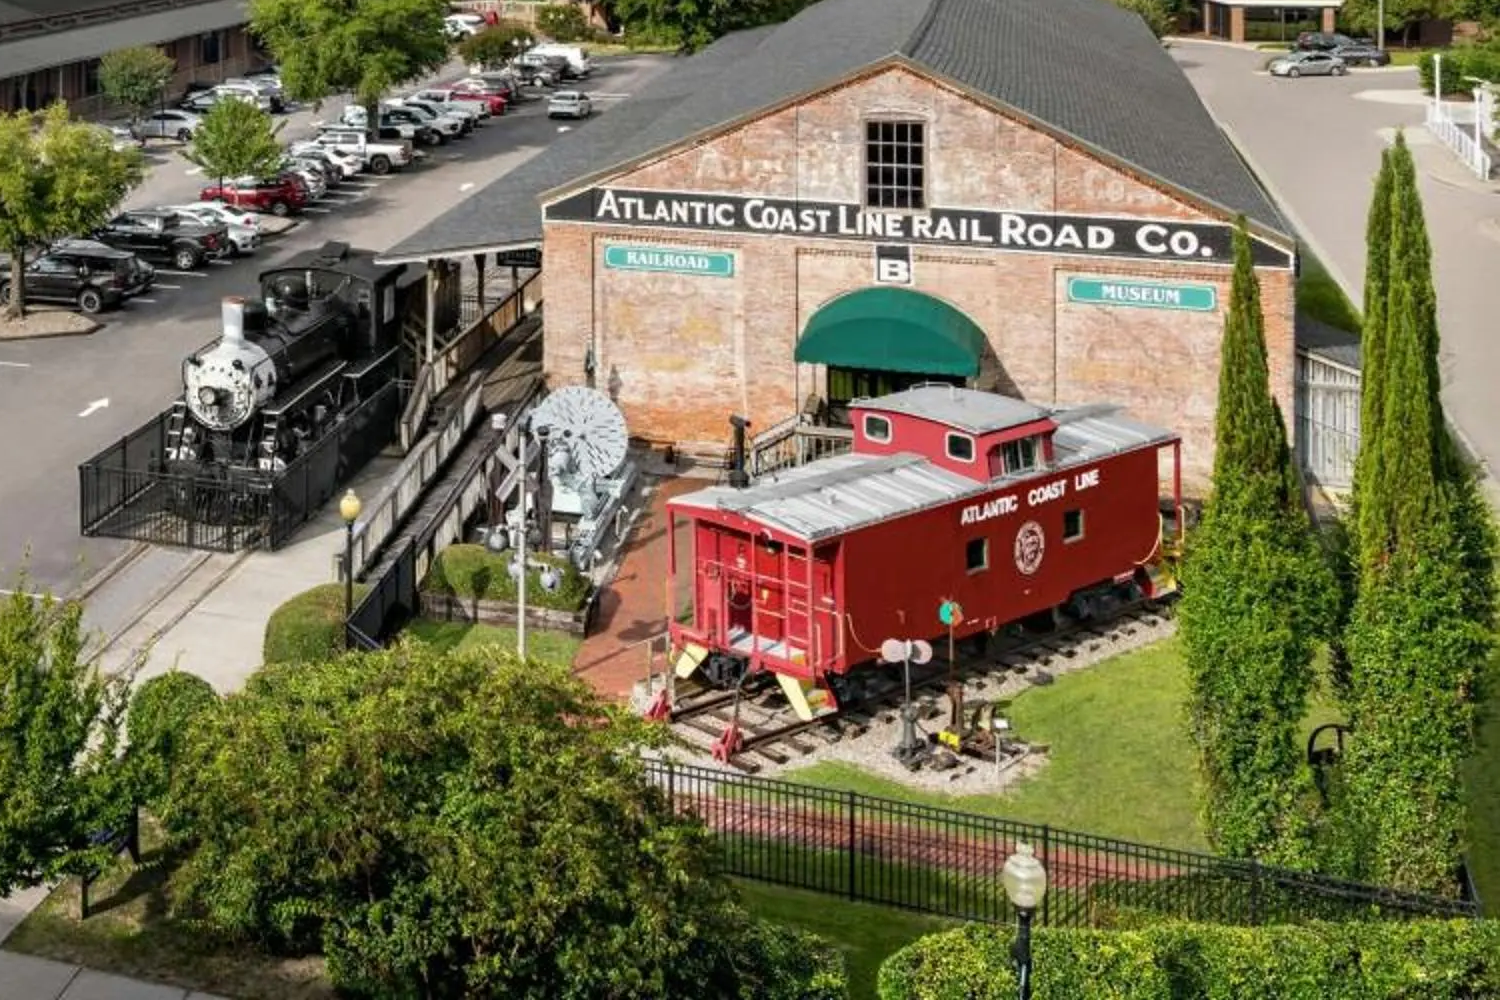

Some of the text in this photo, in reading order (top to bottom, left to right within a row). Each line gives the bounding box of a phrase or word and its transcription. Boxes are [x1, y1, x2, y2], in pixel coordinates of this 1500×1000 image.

[597, 190, 735, 227] ATLANTIC
[743, 199, 831, 233] COAST
[838, 204, 904, 238] LINE
[626, 251, 709, 270] RAILROAD
[879, 259, 909, 282] B
[1101, 284, 1181, 304] MUSEUM
[960, 469, 1100, 526] ATLANTIC COAST LINE
